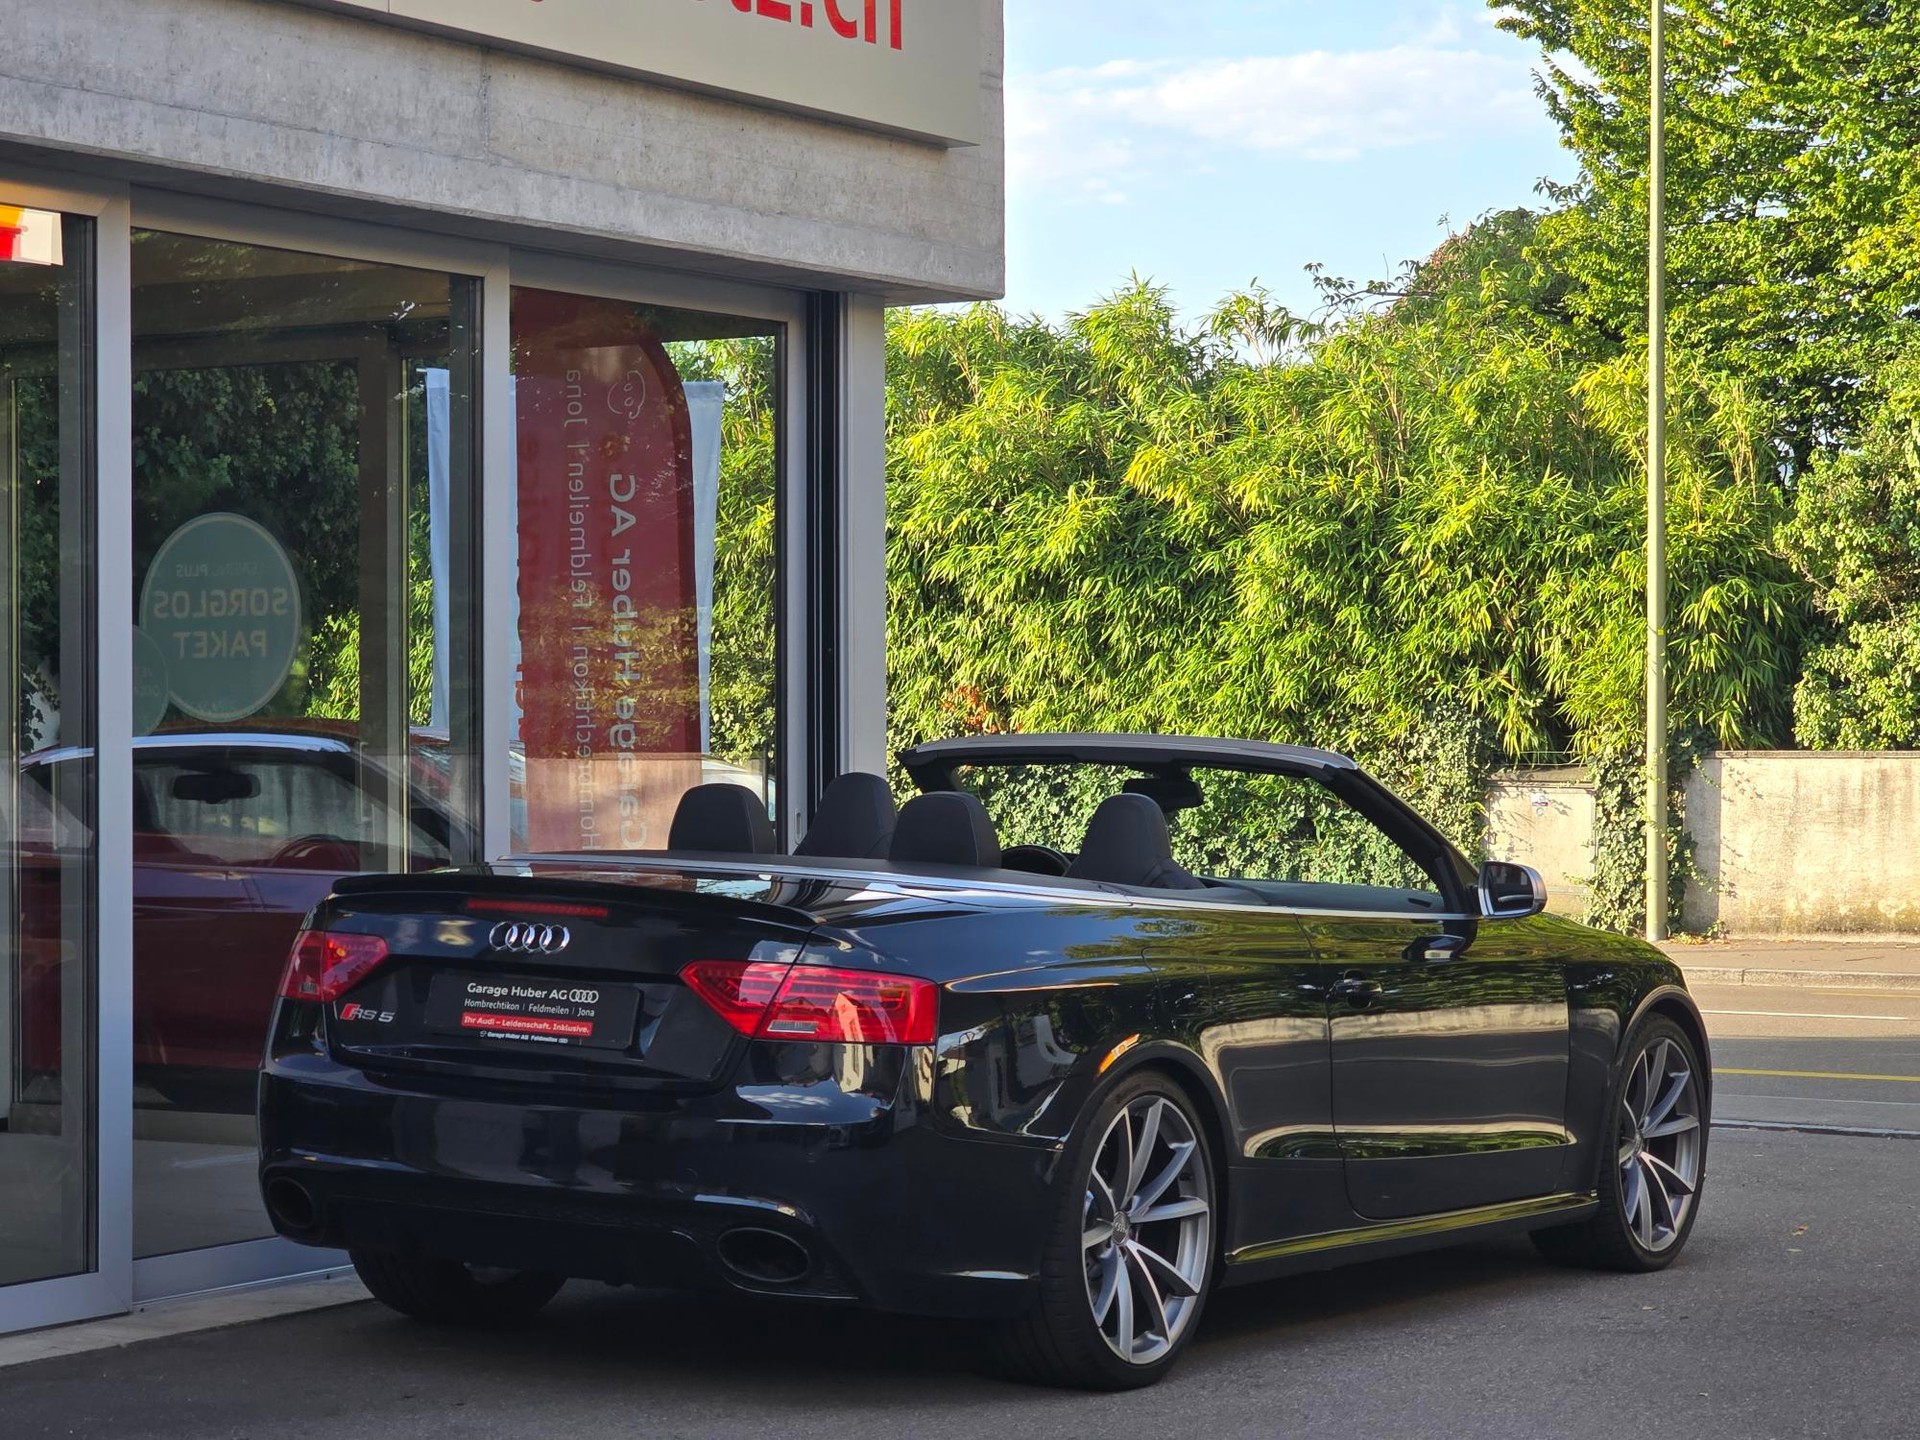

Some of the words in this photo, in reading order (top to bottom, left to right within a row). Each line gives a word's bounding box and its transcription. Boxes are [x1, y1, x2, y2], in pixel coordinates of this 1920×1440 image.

[467, 982, 508, 997] Garage
[511, 986, 547, 999] Huber
[549, 989, 568, 1000] AG
[342, 1004, 378, 1020] RS
[378, 1011, 396, 1023] 5
[464, 998, 520, 1011] Hombrechtikon
[528, 1003, 569, 1015] Feldmeilen
[577, 1007, 595, 1017] Jona
[464, 1016, 476, 1024] Ihr
[477, 1017, 494, 1026] Audi
[501, 1019, 551, 1030] Leidenschaft.
